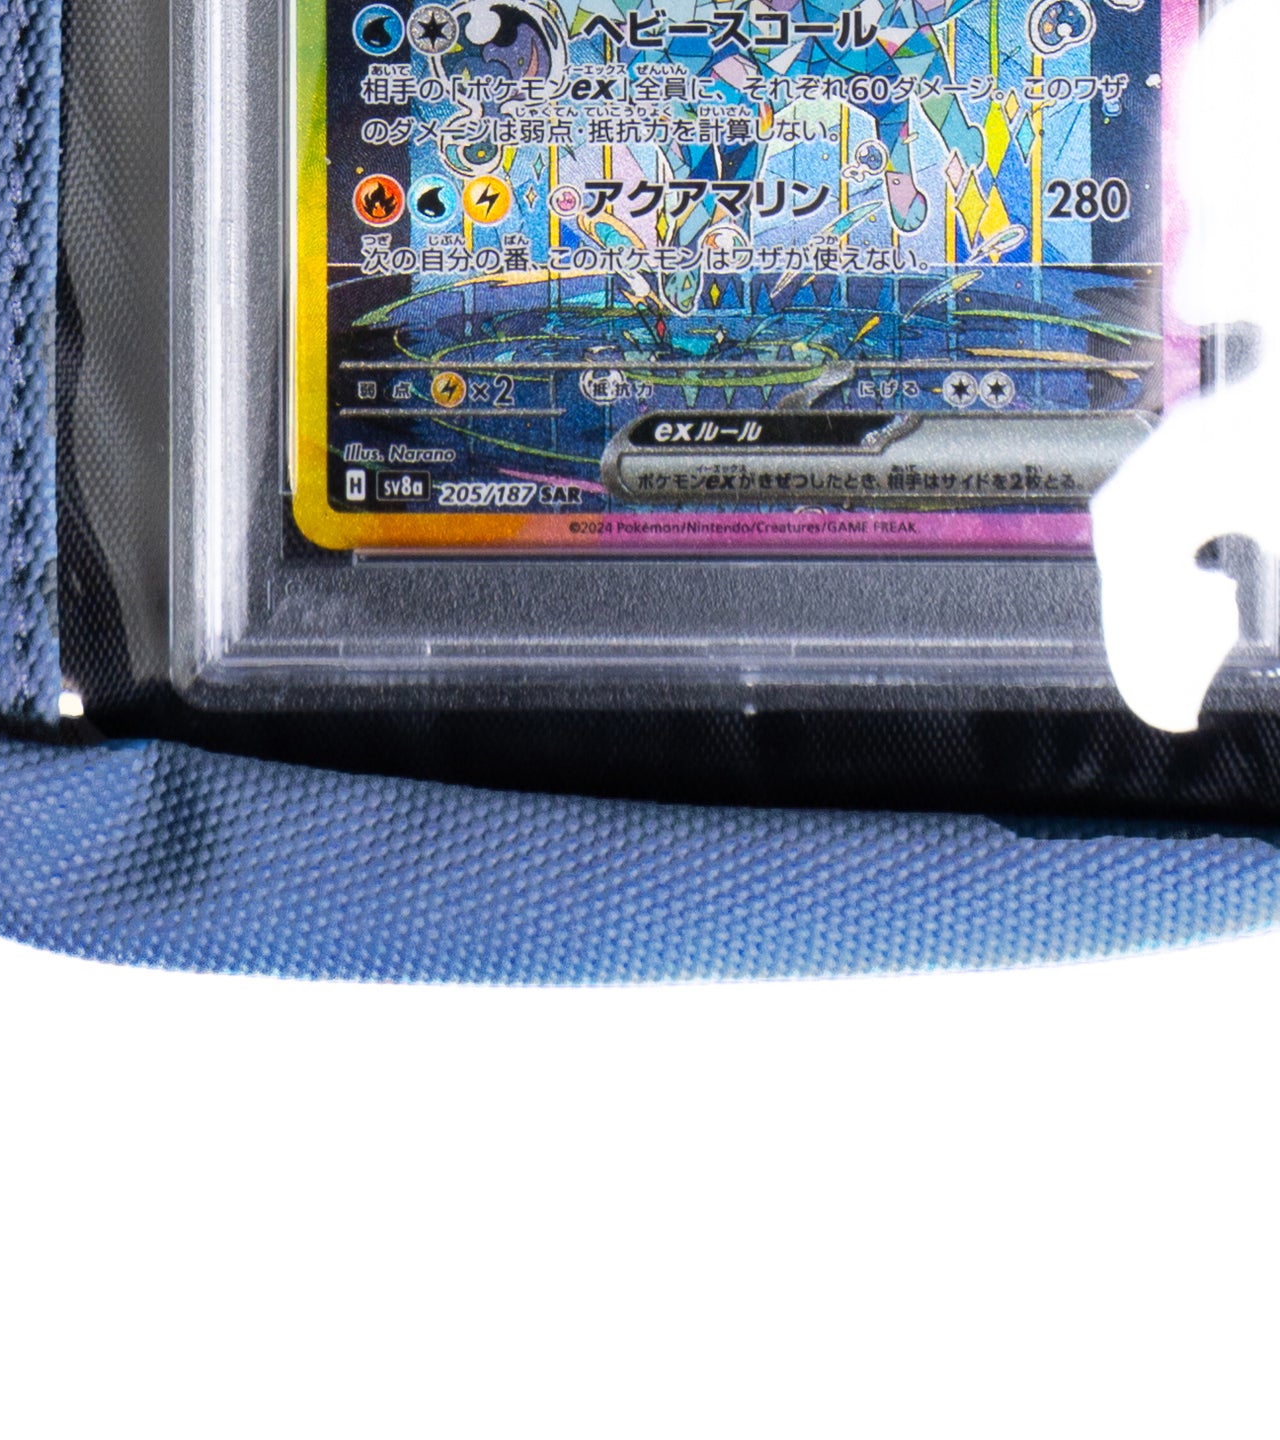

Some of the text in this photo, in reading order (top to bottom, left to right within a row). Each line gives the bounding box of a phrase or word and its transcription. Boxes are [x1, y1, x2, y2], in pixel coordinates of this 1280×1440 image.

[583, 9, 879, 50] ヘビースコール
[583, 178, 830, 220] アクアマリン
[1046, 177, 1132, 221] 280
[653, 419, 763, 443] exルール
[389, 444, 457, 463] Narano
[349, 477, 363, 496] H
[439, 483, 583, 506] 205/187 SAR
